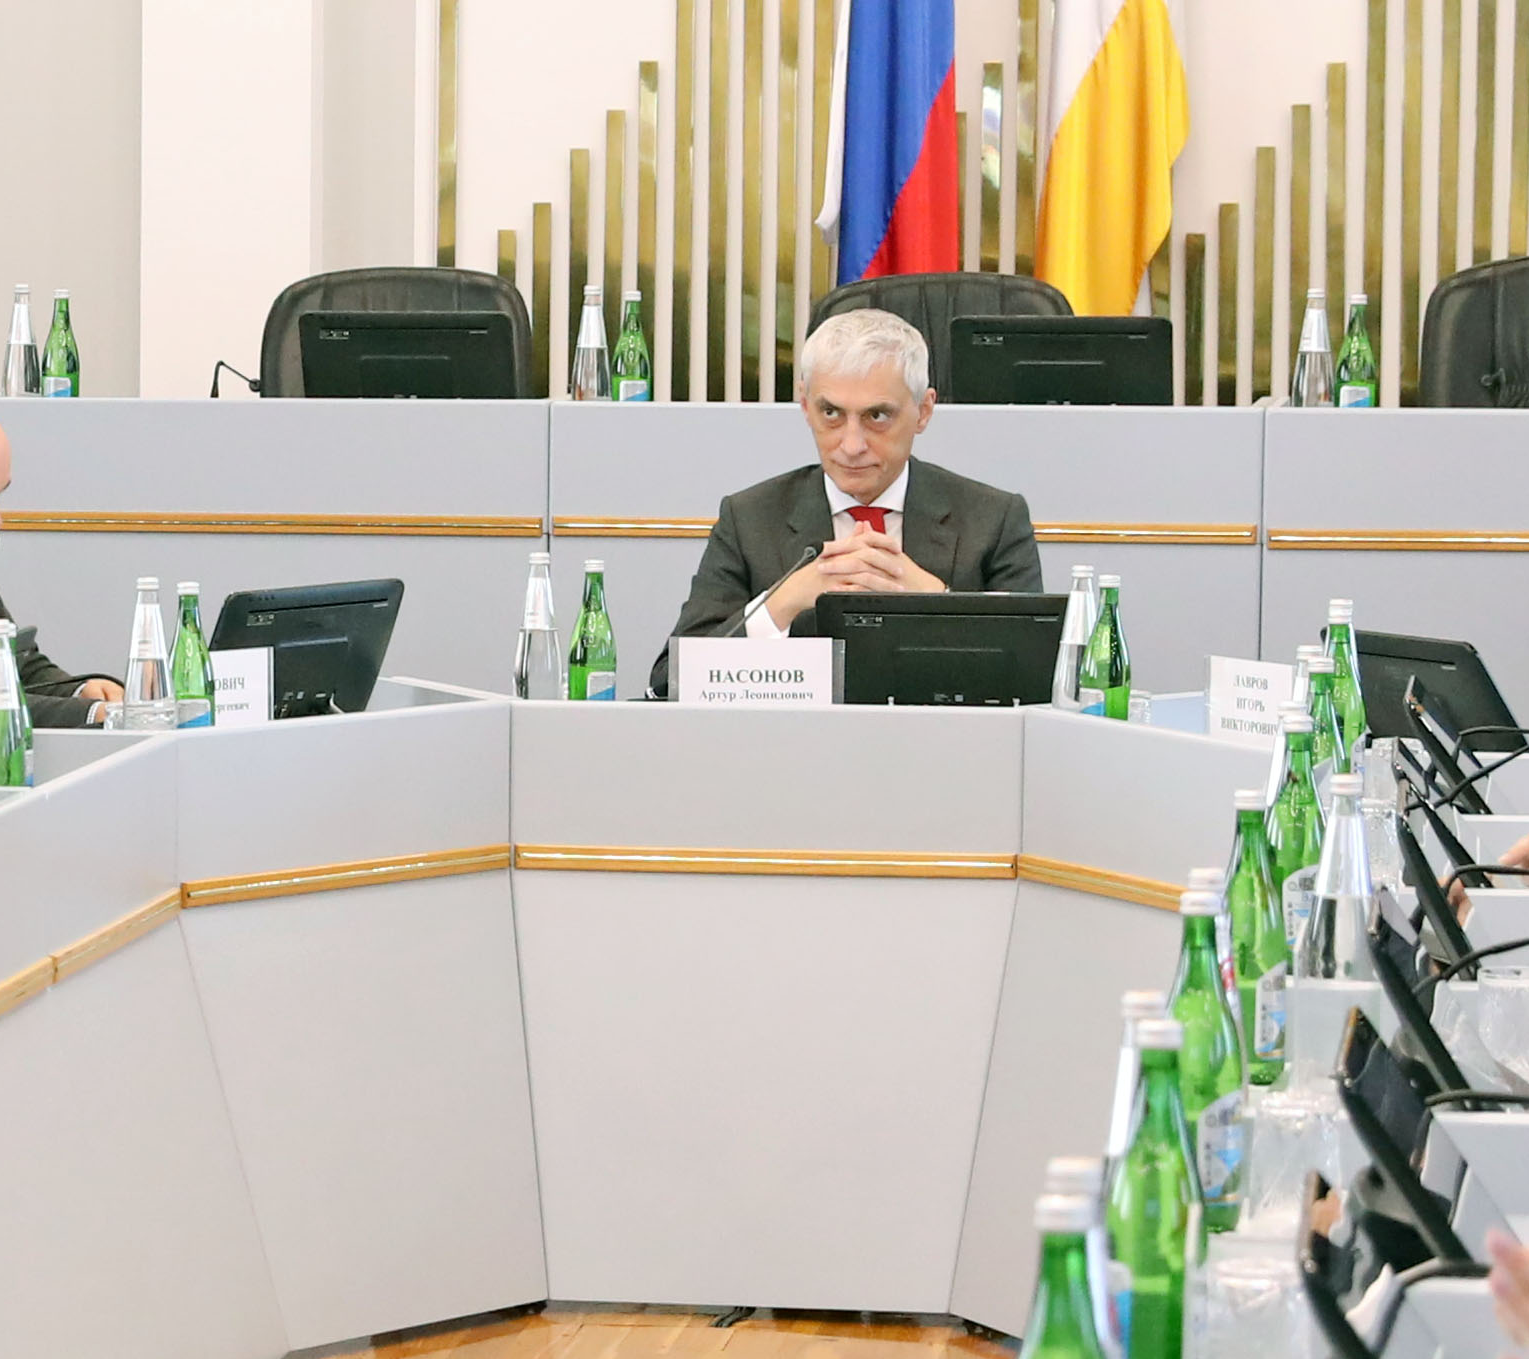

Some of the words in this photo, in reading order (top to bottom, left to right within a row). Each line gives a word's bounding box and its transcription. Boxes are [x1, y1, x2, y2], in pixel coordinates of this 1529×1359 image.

[213, 677, 245, 691] ОВИЧ
[709, 669, 805, 684] НАСОНОВ
[1233, 674, 1268, 690] ЛАВРОВ
[700, 690, 737, 702] Артур
[740, 690, 814, 701] Леонидович
[1236, 696, 1266, 712] ИГОРЬ
